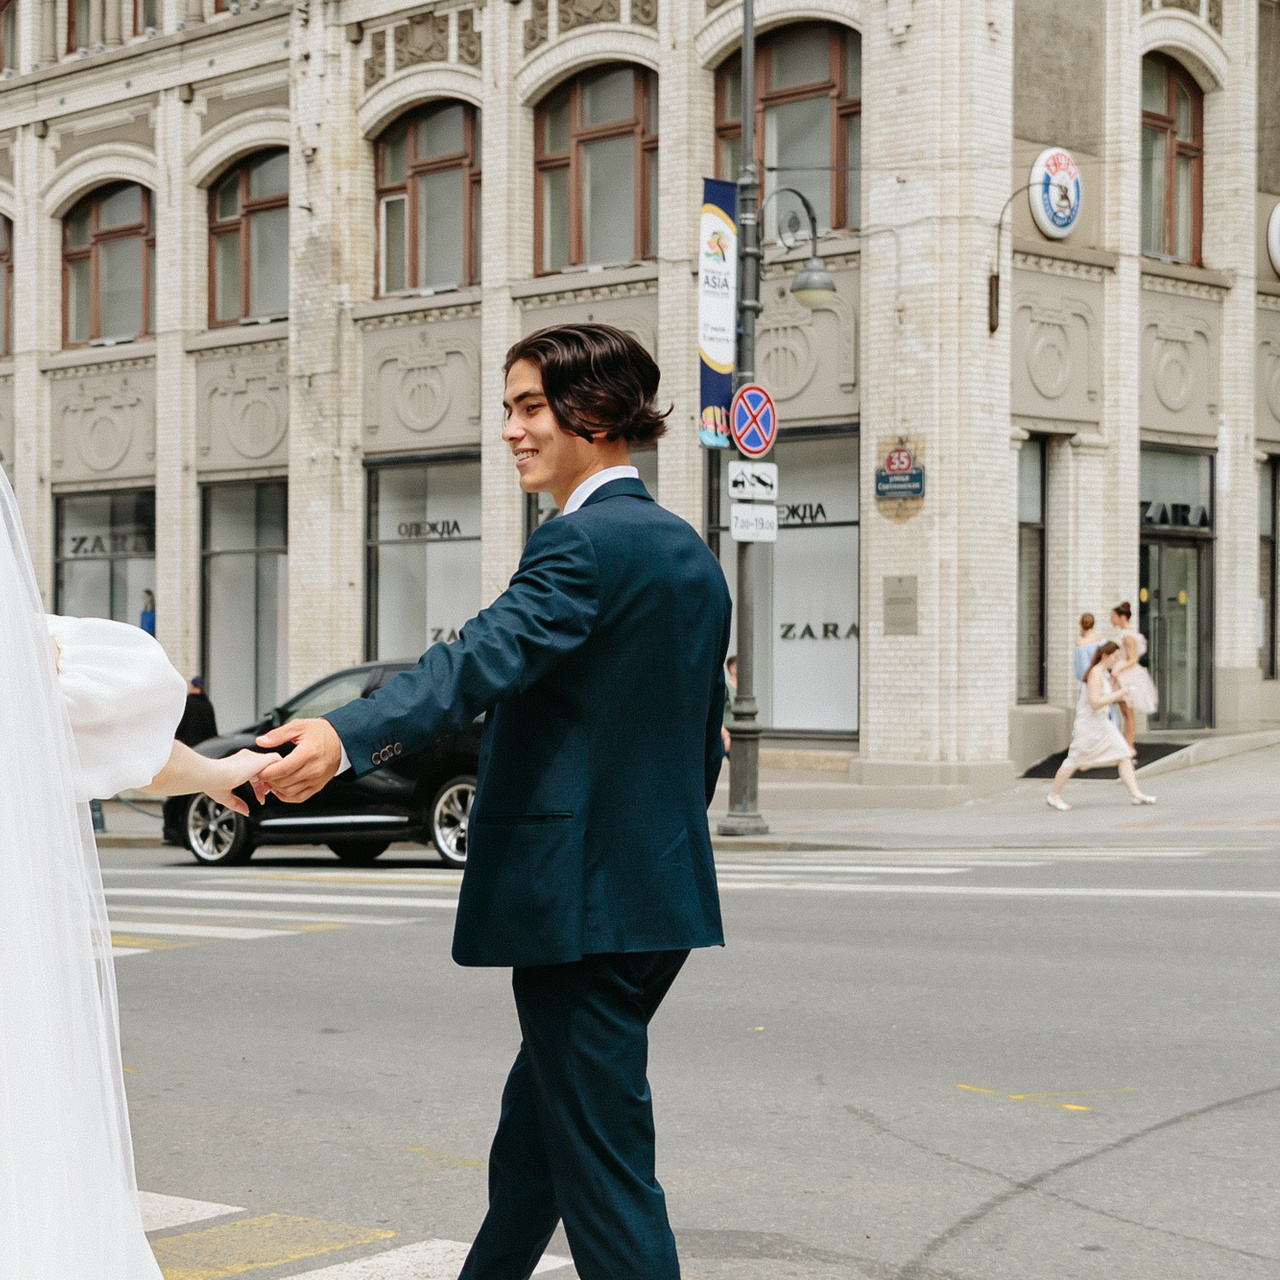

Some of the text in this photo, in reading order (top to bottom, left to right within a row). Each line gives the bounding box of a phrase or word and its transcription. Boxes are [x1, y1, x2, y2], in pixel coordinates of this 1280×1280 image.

[703, 275, 729, 291] ASIA
[890, 451, 909, 470] 35
[1140, 501, 1210, 527] ZARA
[398, 520, 461, 538] ОДЕЖДА
[780, 622, 859, 639] ZARA
